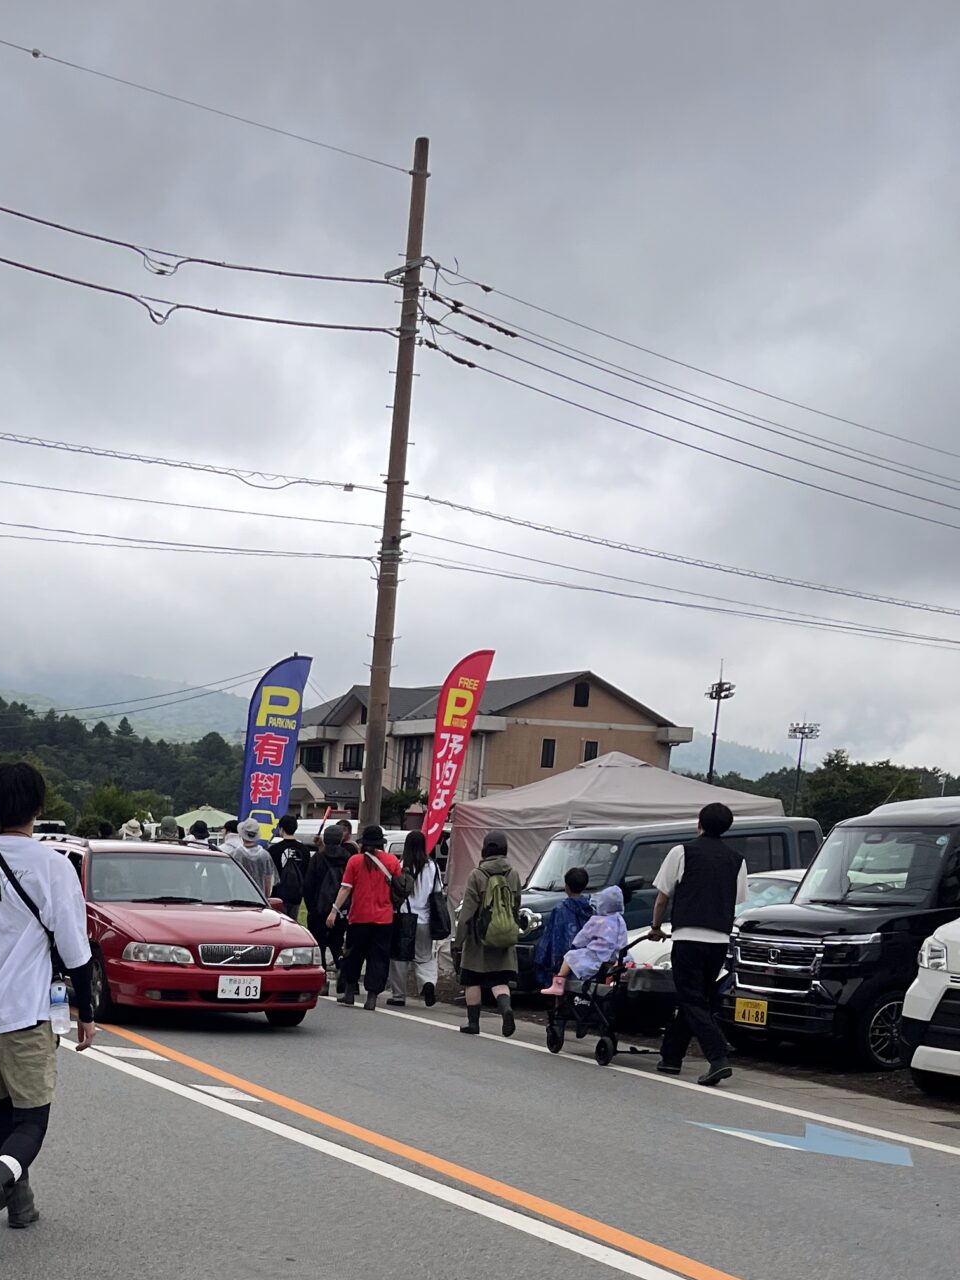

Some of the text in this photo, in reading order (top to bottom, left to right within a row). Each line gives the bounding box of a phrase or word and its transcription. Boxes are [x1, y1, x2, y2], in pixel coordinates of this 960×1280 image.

[458, 676, 480, 691] FREE
[256, 685, 301, 728] P
[268, 716, 297, 731] PARKING
[443, 688, 475, 727] P
[250, 732, 289, 806] 有料
